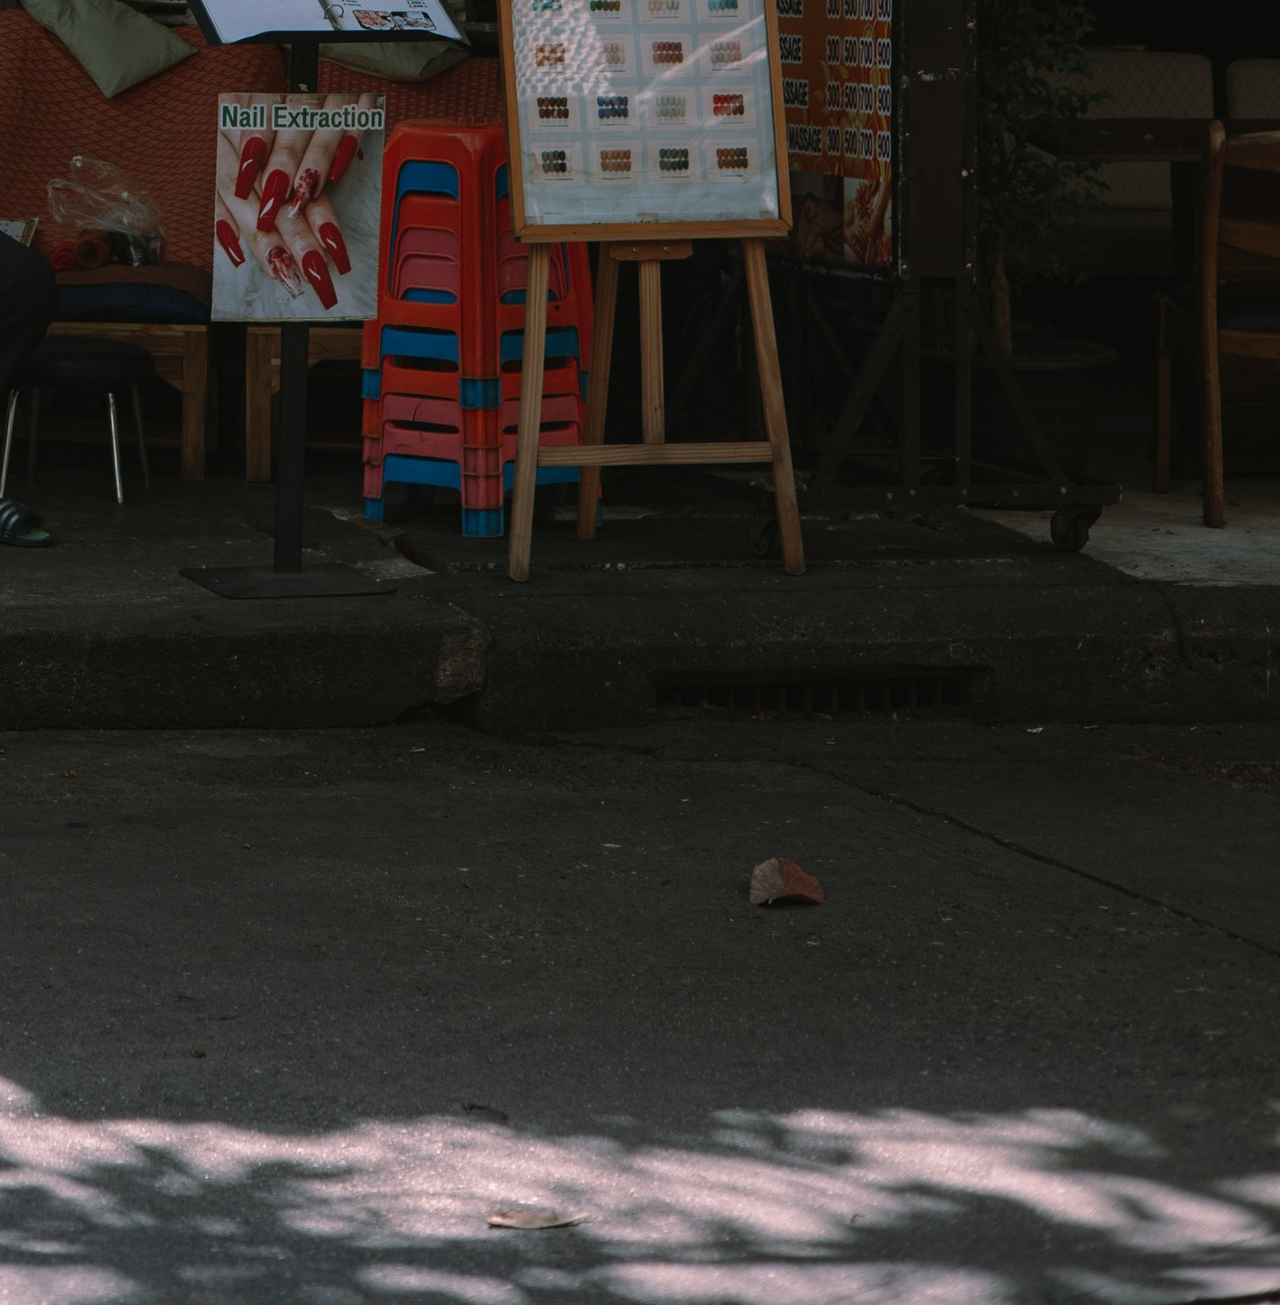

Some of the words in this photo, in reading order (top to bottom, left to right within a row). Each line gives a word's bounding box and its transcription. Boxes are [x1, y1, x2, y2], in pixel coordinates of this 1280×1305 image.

[826, 35, 841, 66] 300
[843, 36, 858, 66] 500
[859, 36, 874, 68] 700
[876, 37, 892, 70] 900
[826, 81, 841, 111] 300
[843, 82, 858, 112] 500
[859, 83, 874, 114] 700
[876, 84, 892, 116] 900
[221, 104, 266, 129] Nail
[272, 104, 384, 130] Extraction
[787, 124, 822, 156] MASSAGE
[826, 126, 841, 156] 300
[843, 127, 858, 158] 500
[859, 129, 874, 160] 700
[876, 130, 892, 163] 900
